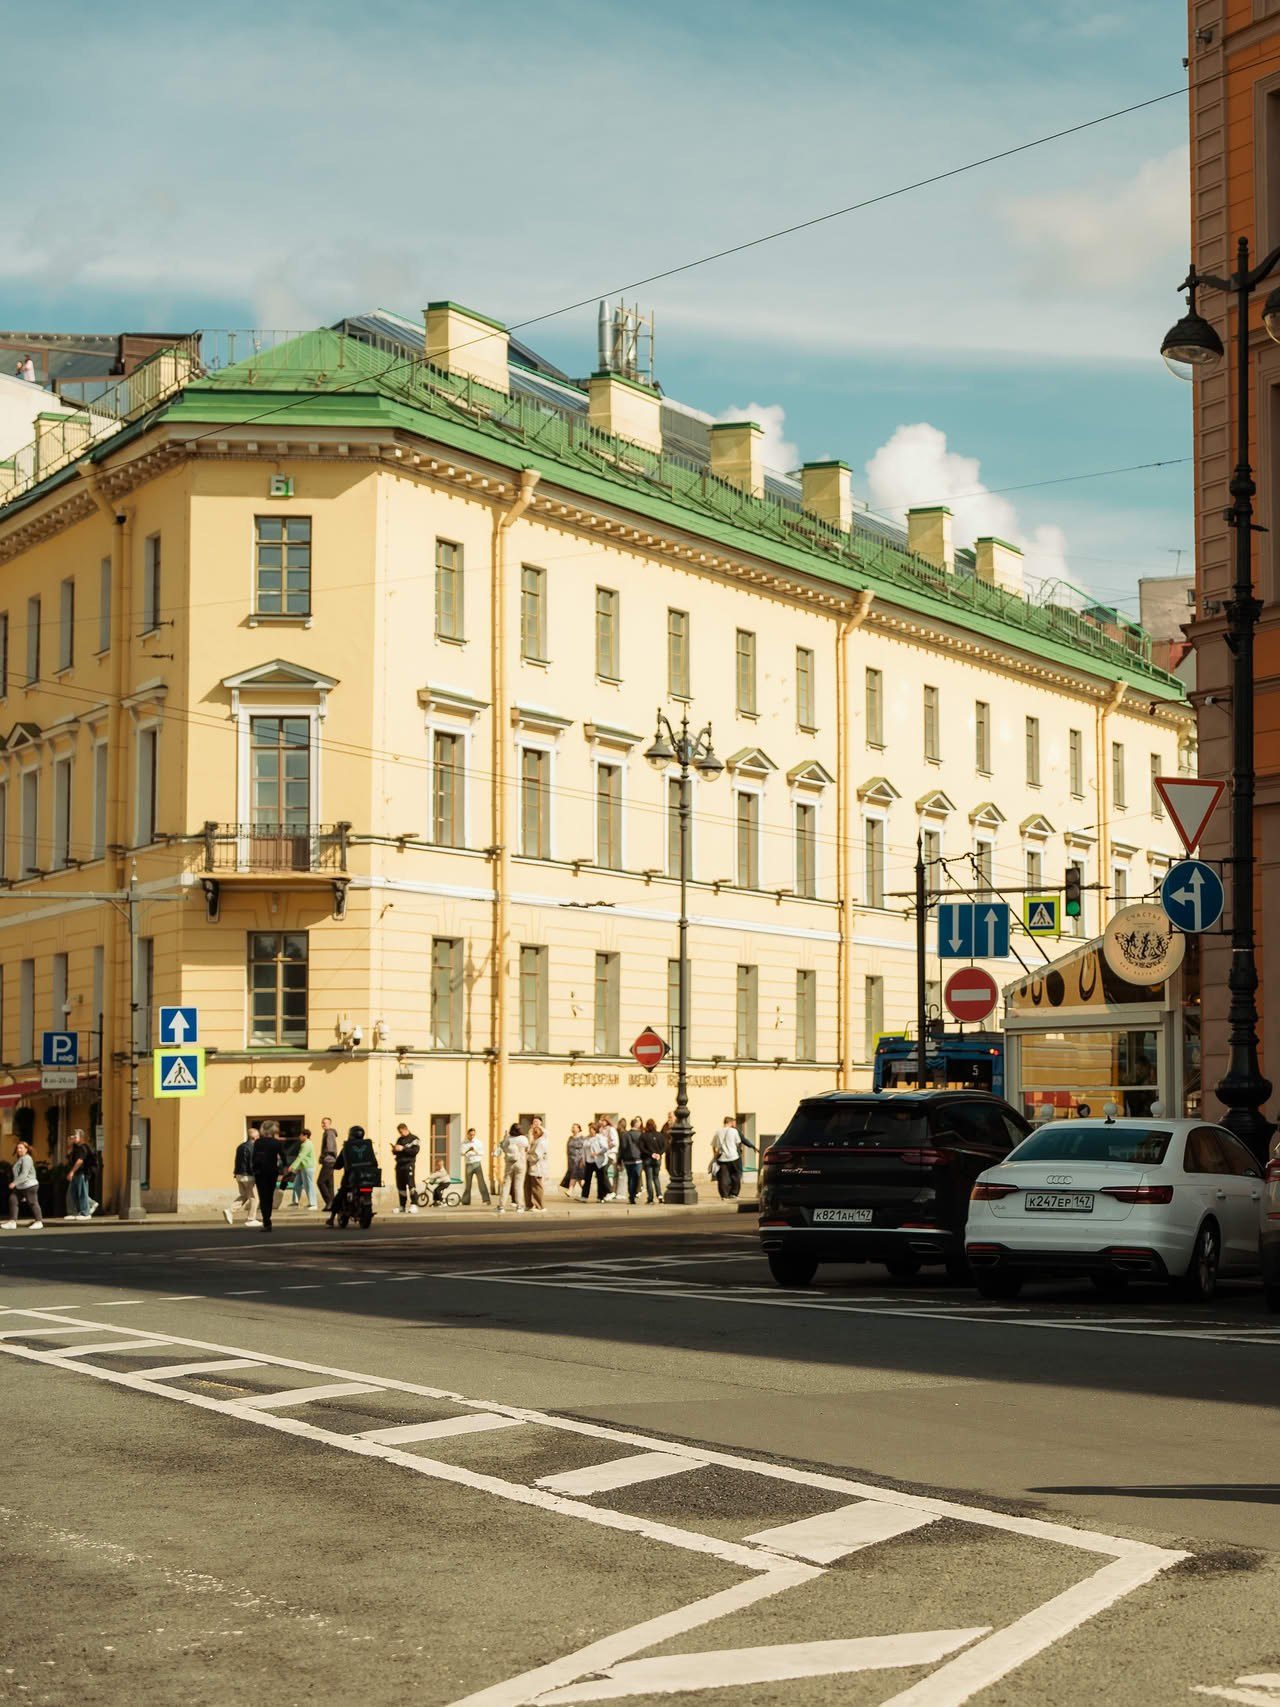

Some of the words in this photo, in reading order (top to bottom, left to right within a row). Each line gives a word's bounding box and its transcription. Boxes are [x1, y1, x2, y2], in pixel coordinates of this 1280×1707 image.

[971, 1064, 980, 1076] 5
[1073, 1196, 1091, 1206] 147
[856, 1210, 871, 1219] 147
